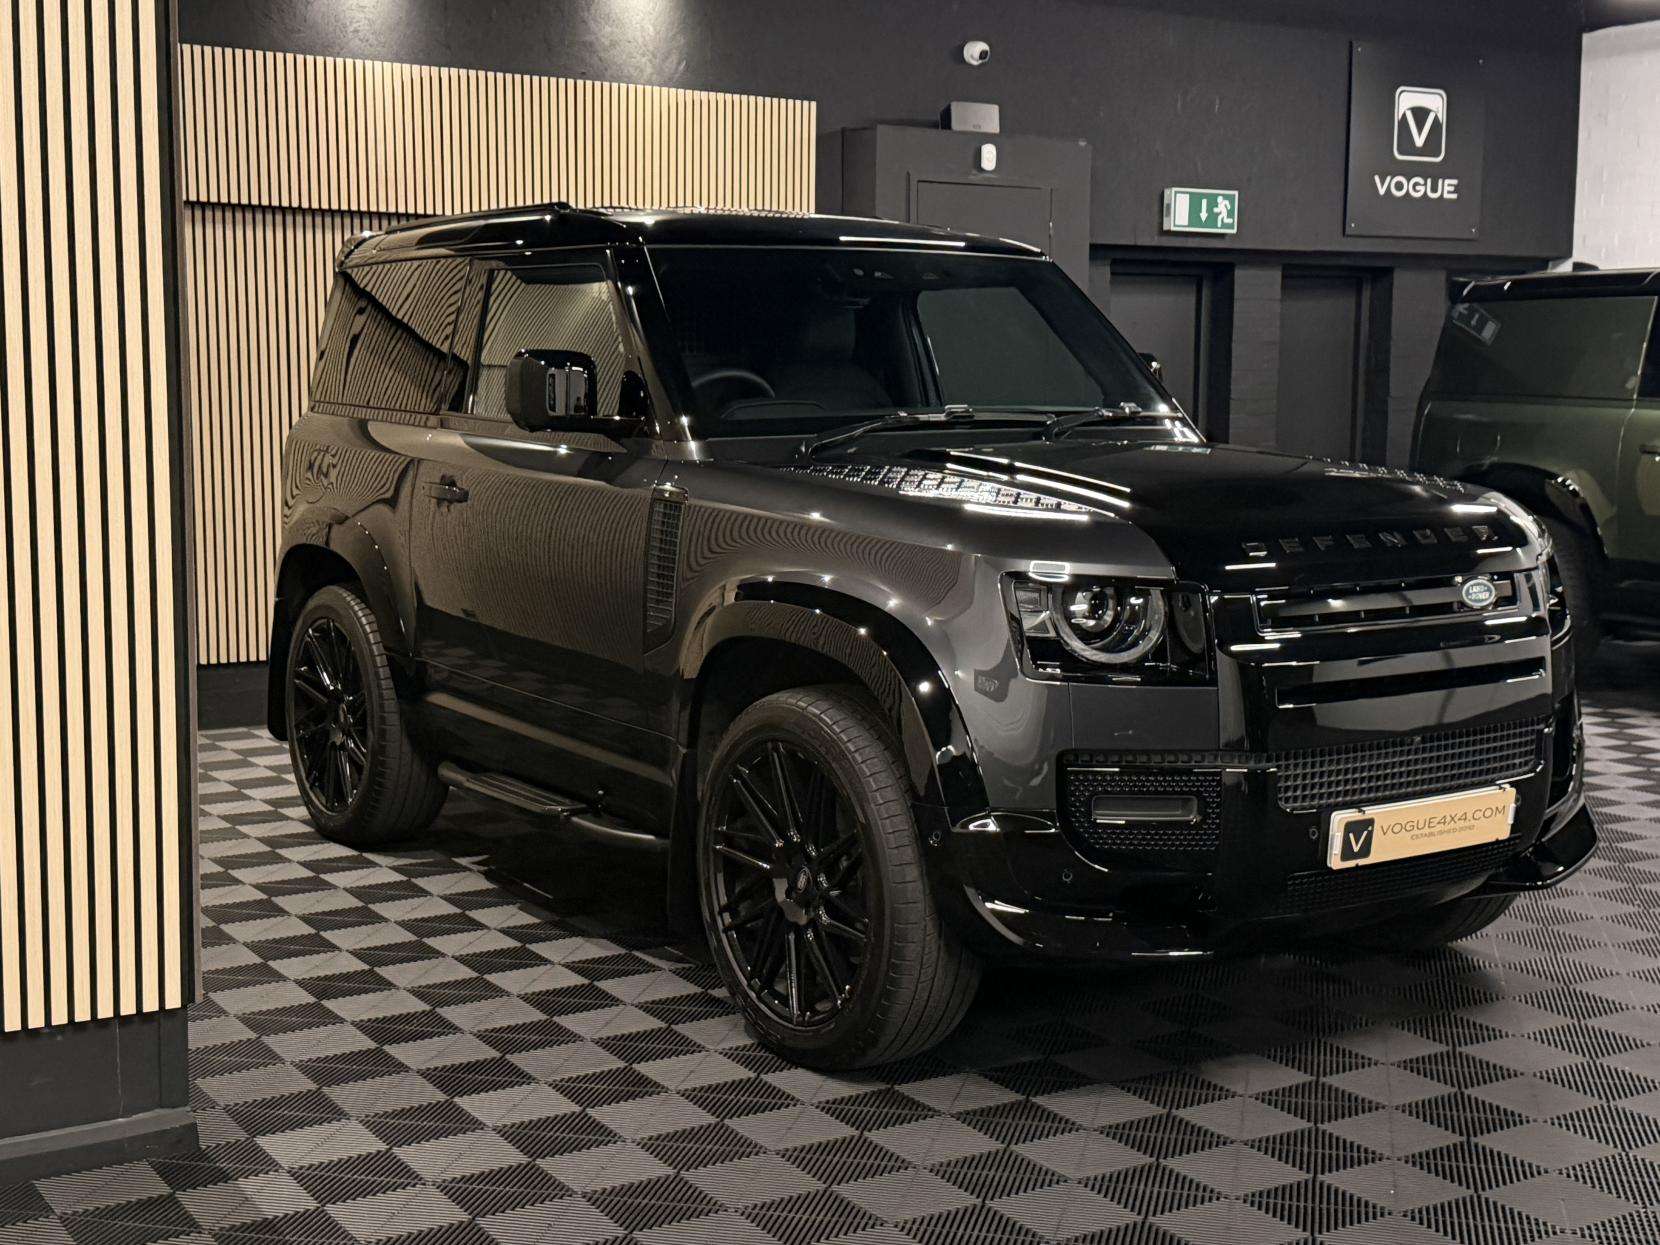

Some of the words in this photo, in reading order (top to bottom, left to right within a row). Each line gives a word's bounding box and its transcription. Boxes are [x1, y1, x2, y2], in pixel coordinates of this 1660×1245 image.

[1374, 174, 1459, 199] VOGUE
[1242, 525, 1498, 556] DEFENDER
[1381, 805, 1506, 836] VOGUE4X4.COM
